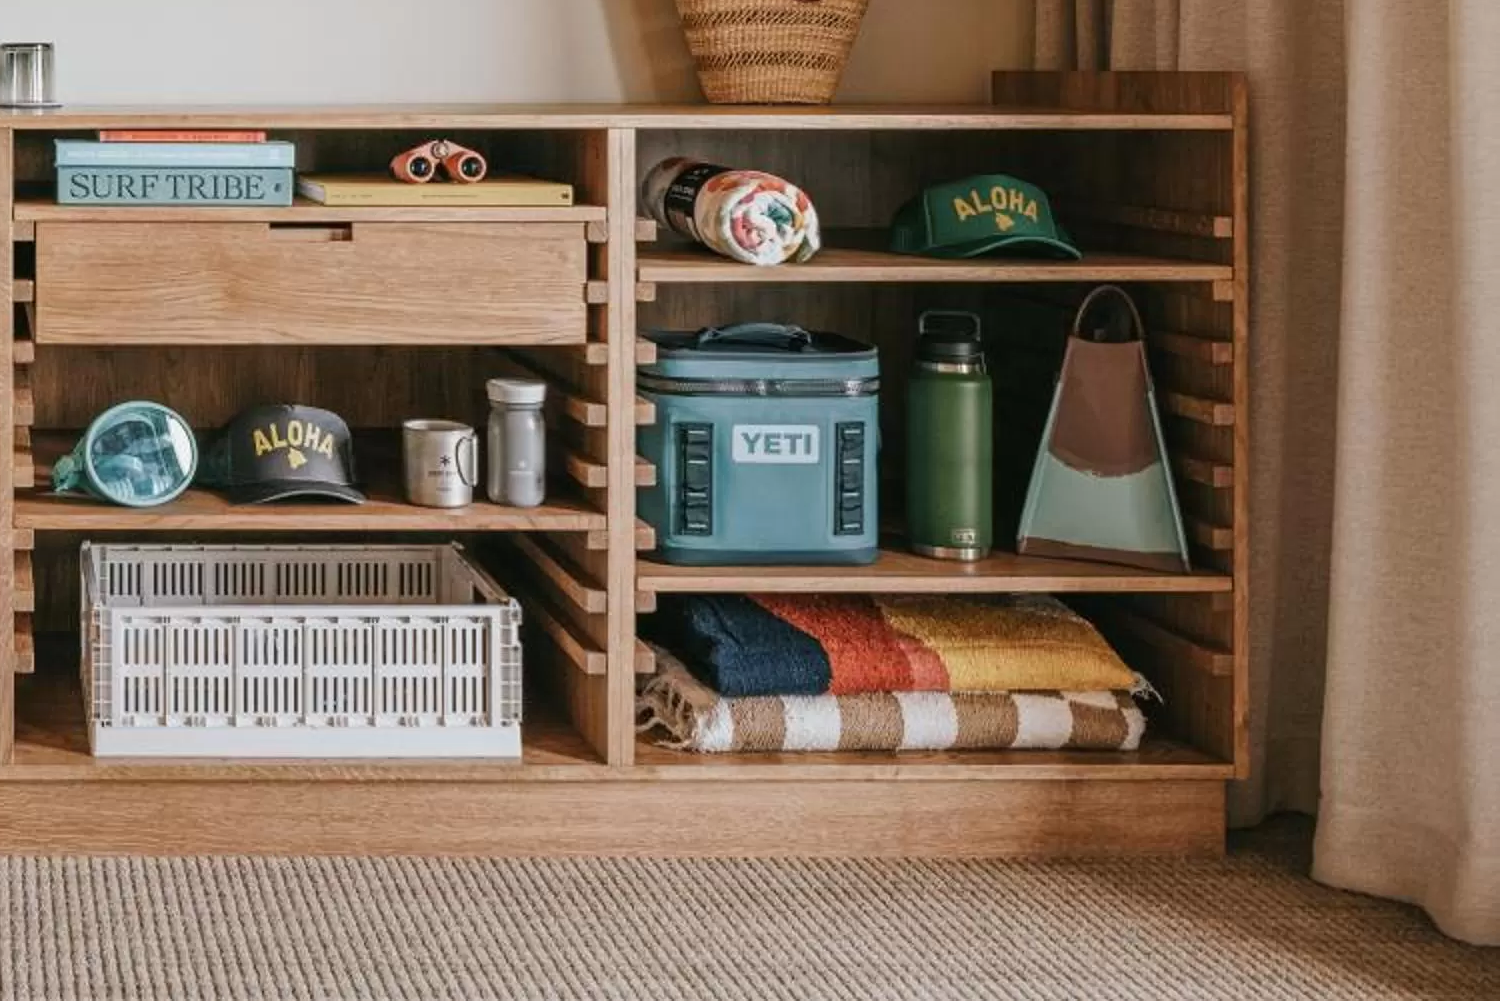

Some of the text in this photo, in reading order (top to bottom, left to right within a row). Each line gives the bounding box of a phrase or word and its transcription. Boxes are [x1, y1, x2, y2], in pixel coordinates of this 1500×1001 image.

[70, 173, 266, 200] SURF TRIBE
[953, 186, 1038, 223] ALOHA
[253, 420, 334, 459] ALOHA
[740, 432, 812, 455] YETI
